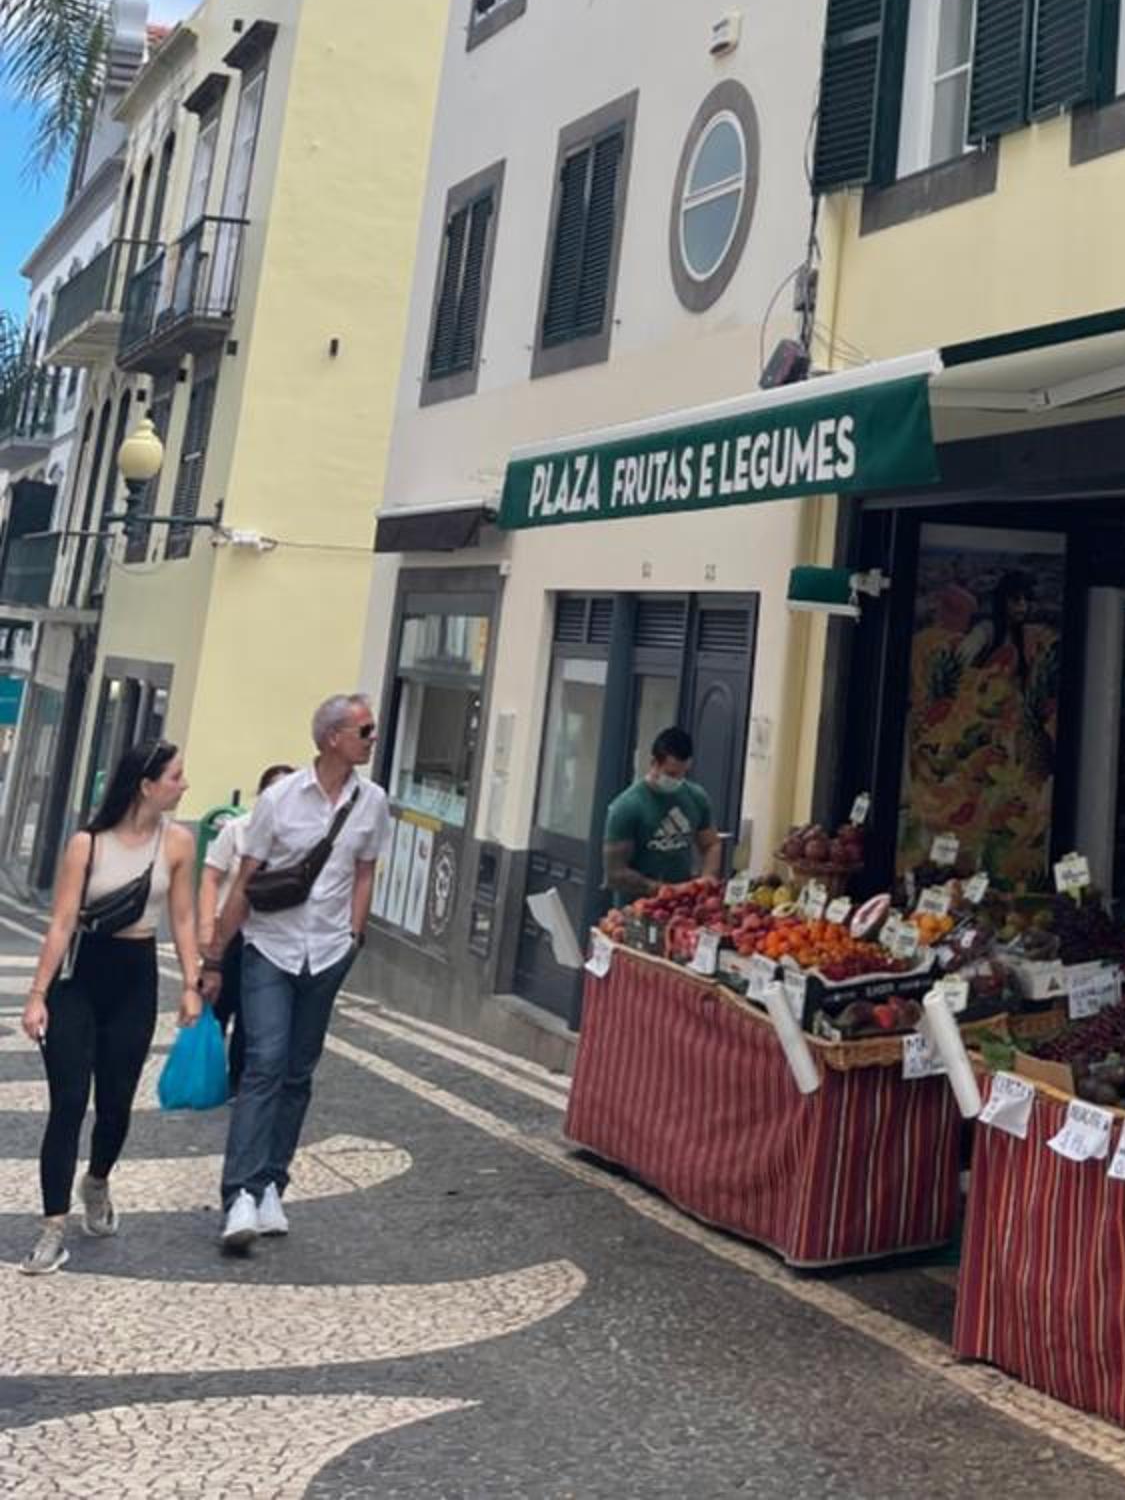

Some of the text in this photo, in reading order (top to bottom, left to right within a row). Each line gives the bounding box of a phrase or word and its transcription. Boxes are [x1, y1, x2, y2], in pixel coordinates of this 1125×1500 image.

[528, 415, 857, 519] PLAZA FRUTAS E LEGUMES
